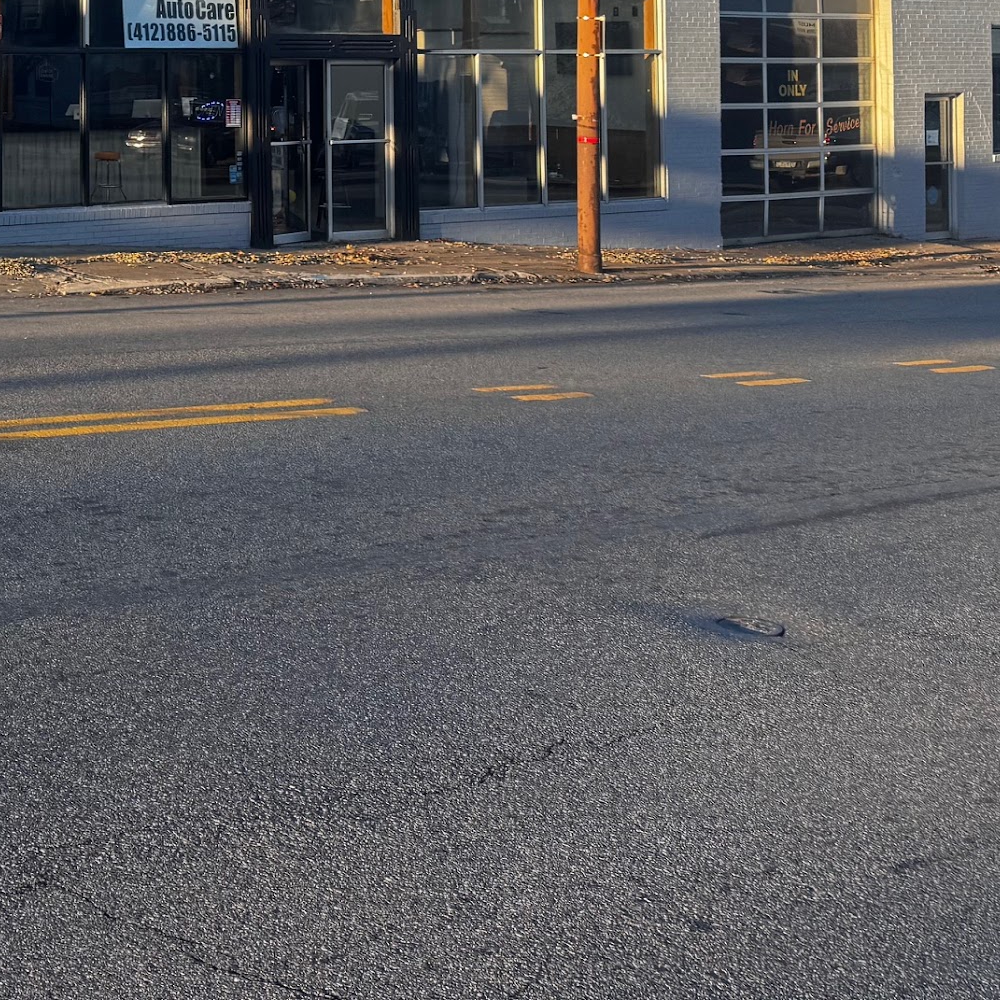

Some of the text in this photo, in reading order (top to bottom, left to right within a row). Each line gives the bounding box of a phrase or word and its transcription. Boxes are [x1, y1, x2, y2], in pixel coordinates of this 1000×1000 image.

[127, 22, 236, 42] (412)886-5115
[788, 70, 799, 81] IN
[779, 85, 807, 96] ONLY
[769, 117, 860, 136] Horn For Service
